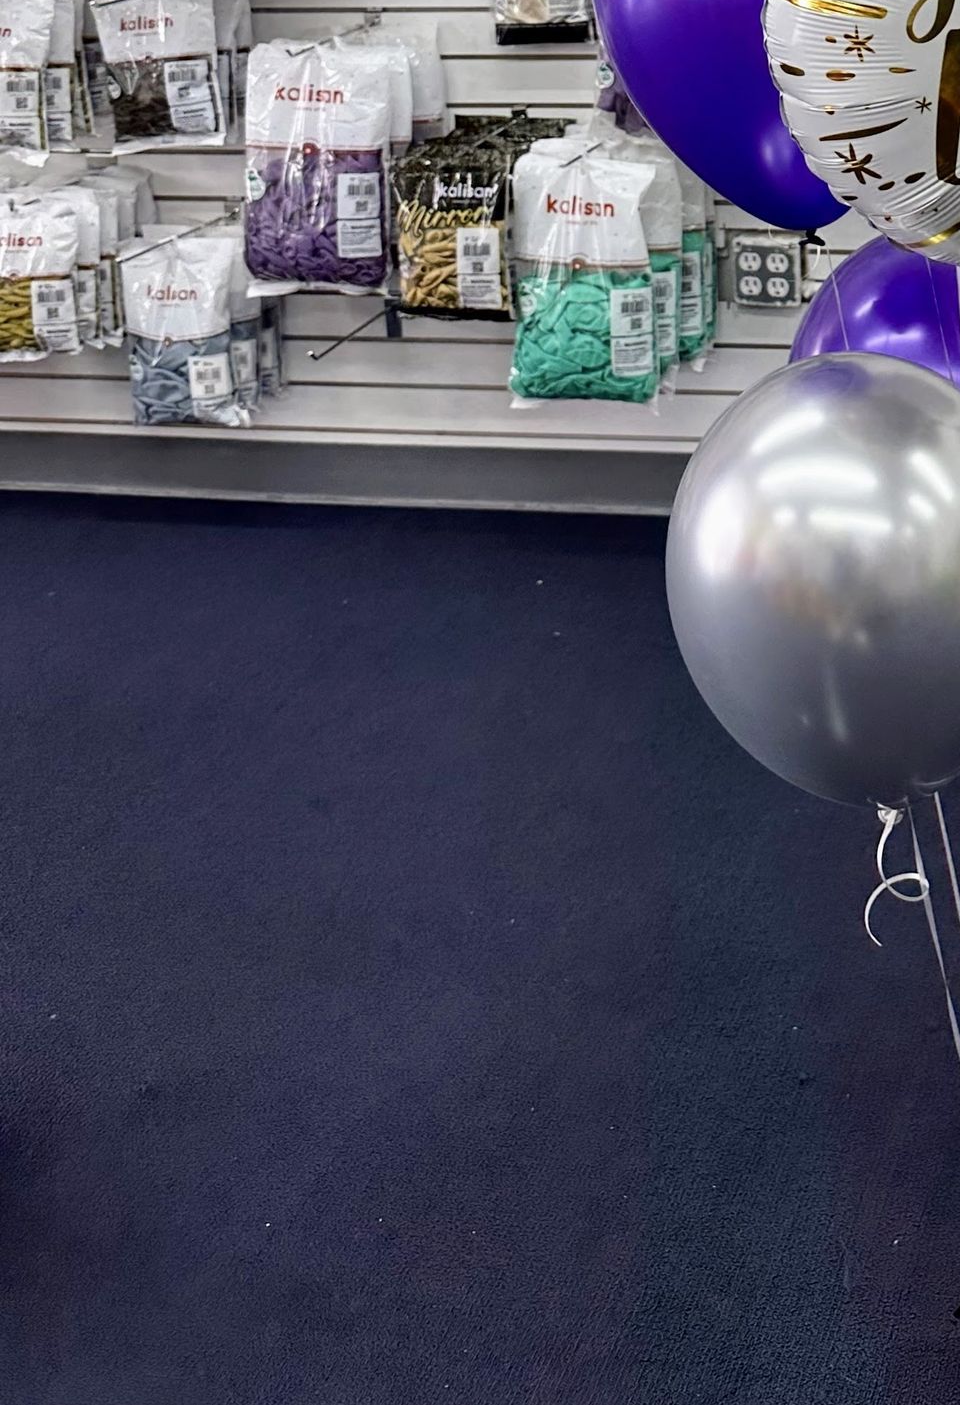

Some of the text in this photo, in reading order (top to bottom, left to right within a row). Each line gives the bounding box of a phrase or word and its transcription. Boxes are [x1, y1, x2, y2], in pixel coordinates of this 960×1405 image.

[120, 16, 173, 33] kalisn
[274, 83, 344, 105] kalisan
[438, 181, 495, 199] kalisan
[547, 194, 615, 217] kalisan
[400, 198, 490, 236] Mirror
[0, 233, 43, 248] alisan
